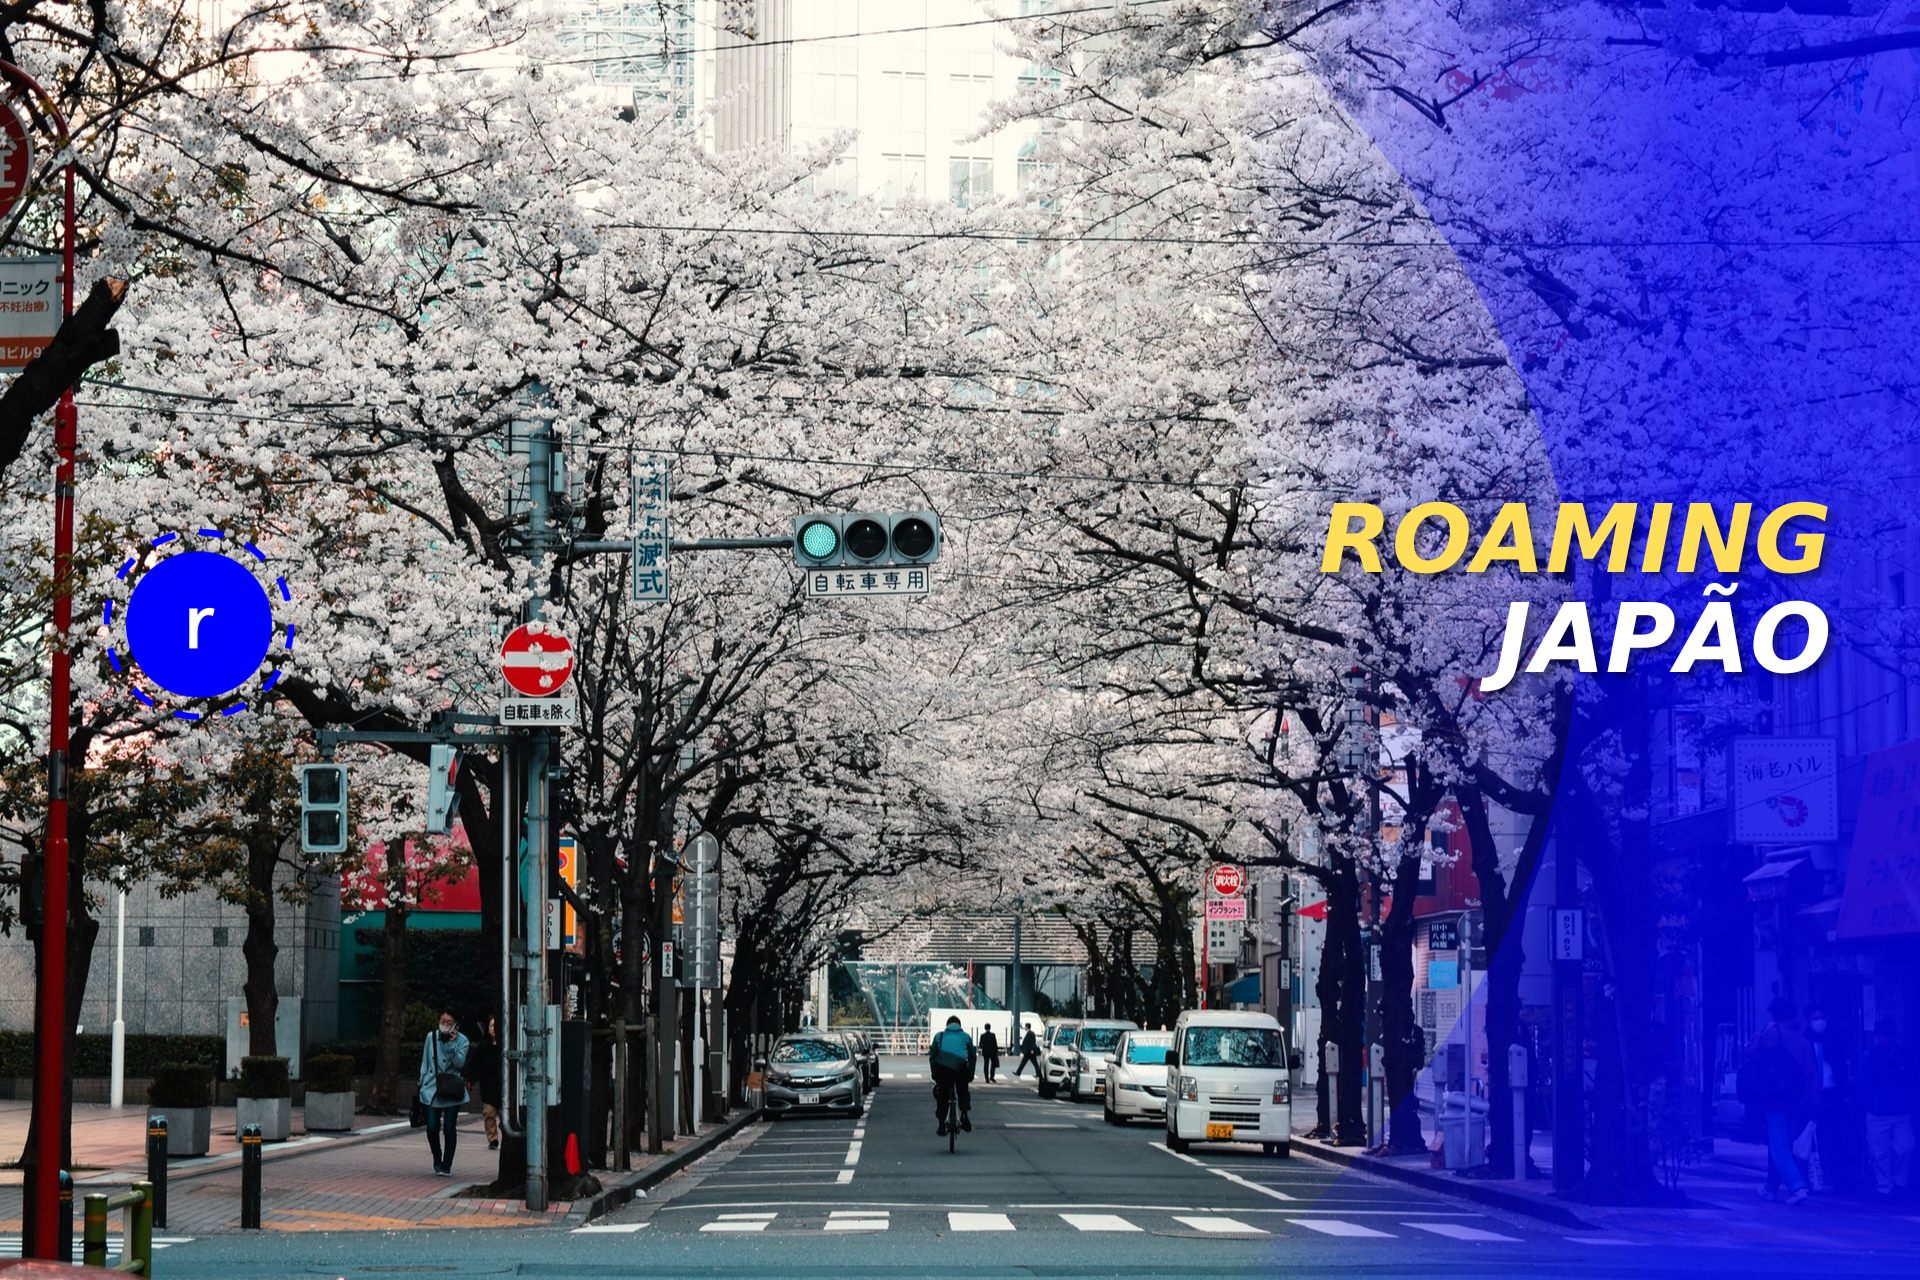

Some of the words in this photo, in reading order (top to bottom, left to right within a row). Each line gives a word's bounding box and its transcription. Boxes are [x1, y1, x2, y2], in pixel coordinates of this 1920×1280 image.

[0, 279, 49, 296] ニック
[815, 571, 924, 592] 自転車専用
[504, 704, 571, 720] 自転車を除く
[1744, 754, 1823, 782] 海老バル
[1215, 875, 1239, 888] 消火栓
